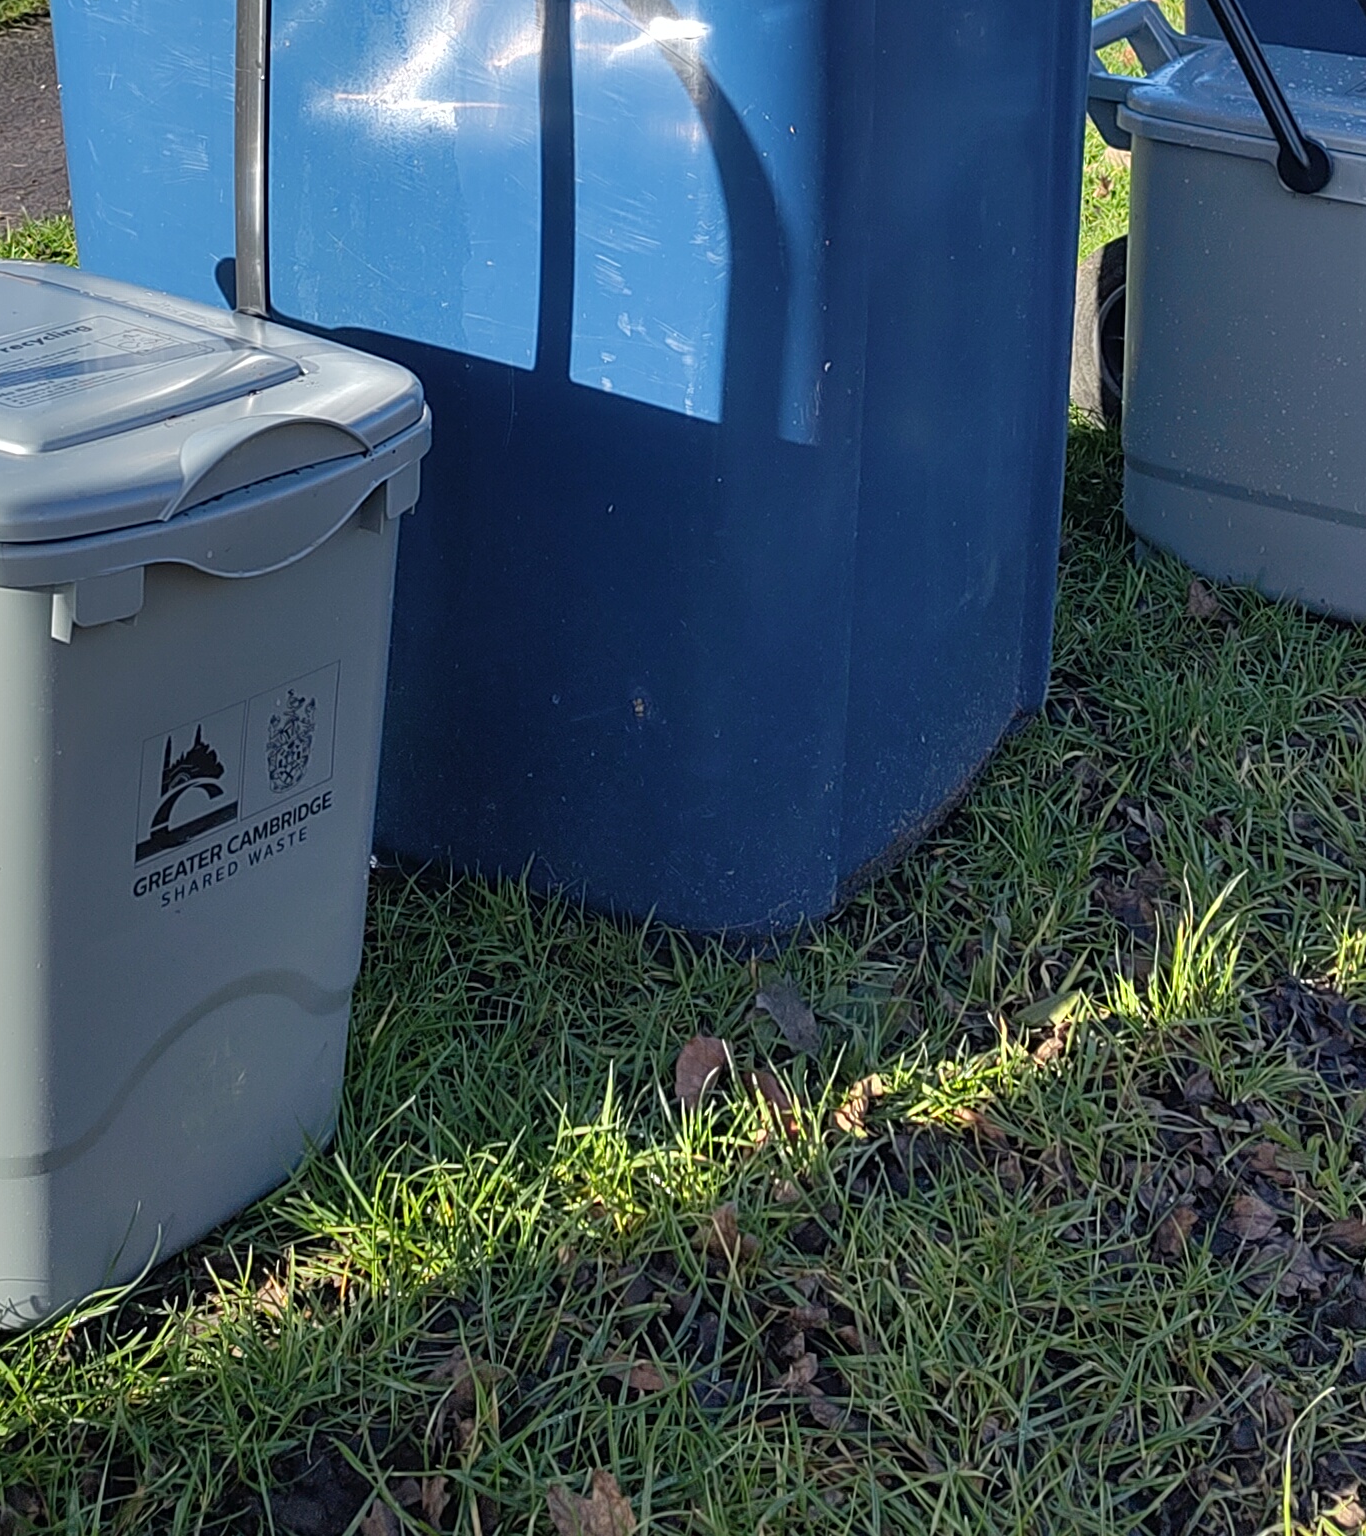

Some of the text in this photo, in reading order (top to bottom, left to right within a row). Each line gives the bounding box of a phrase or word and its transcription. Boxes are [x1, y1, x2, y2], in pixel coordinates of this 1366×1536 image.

[0, 325, 93, 354] recycling
[133, 790, 333, 899] GREATER CAMBRIDGE
[161, 827, 308, 908] SHARED WASTE
